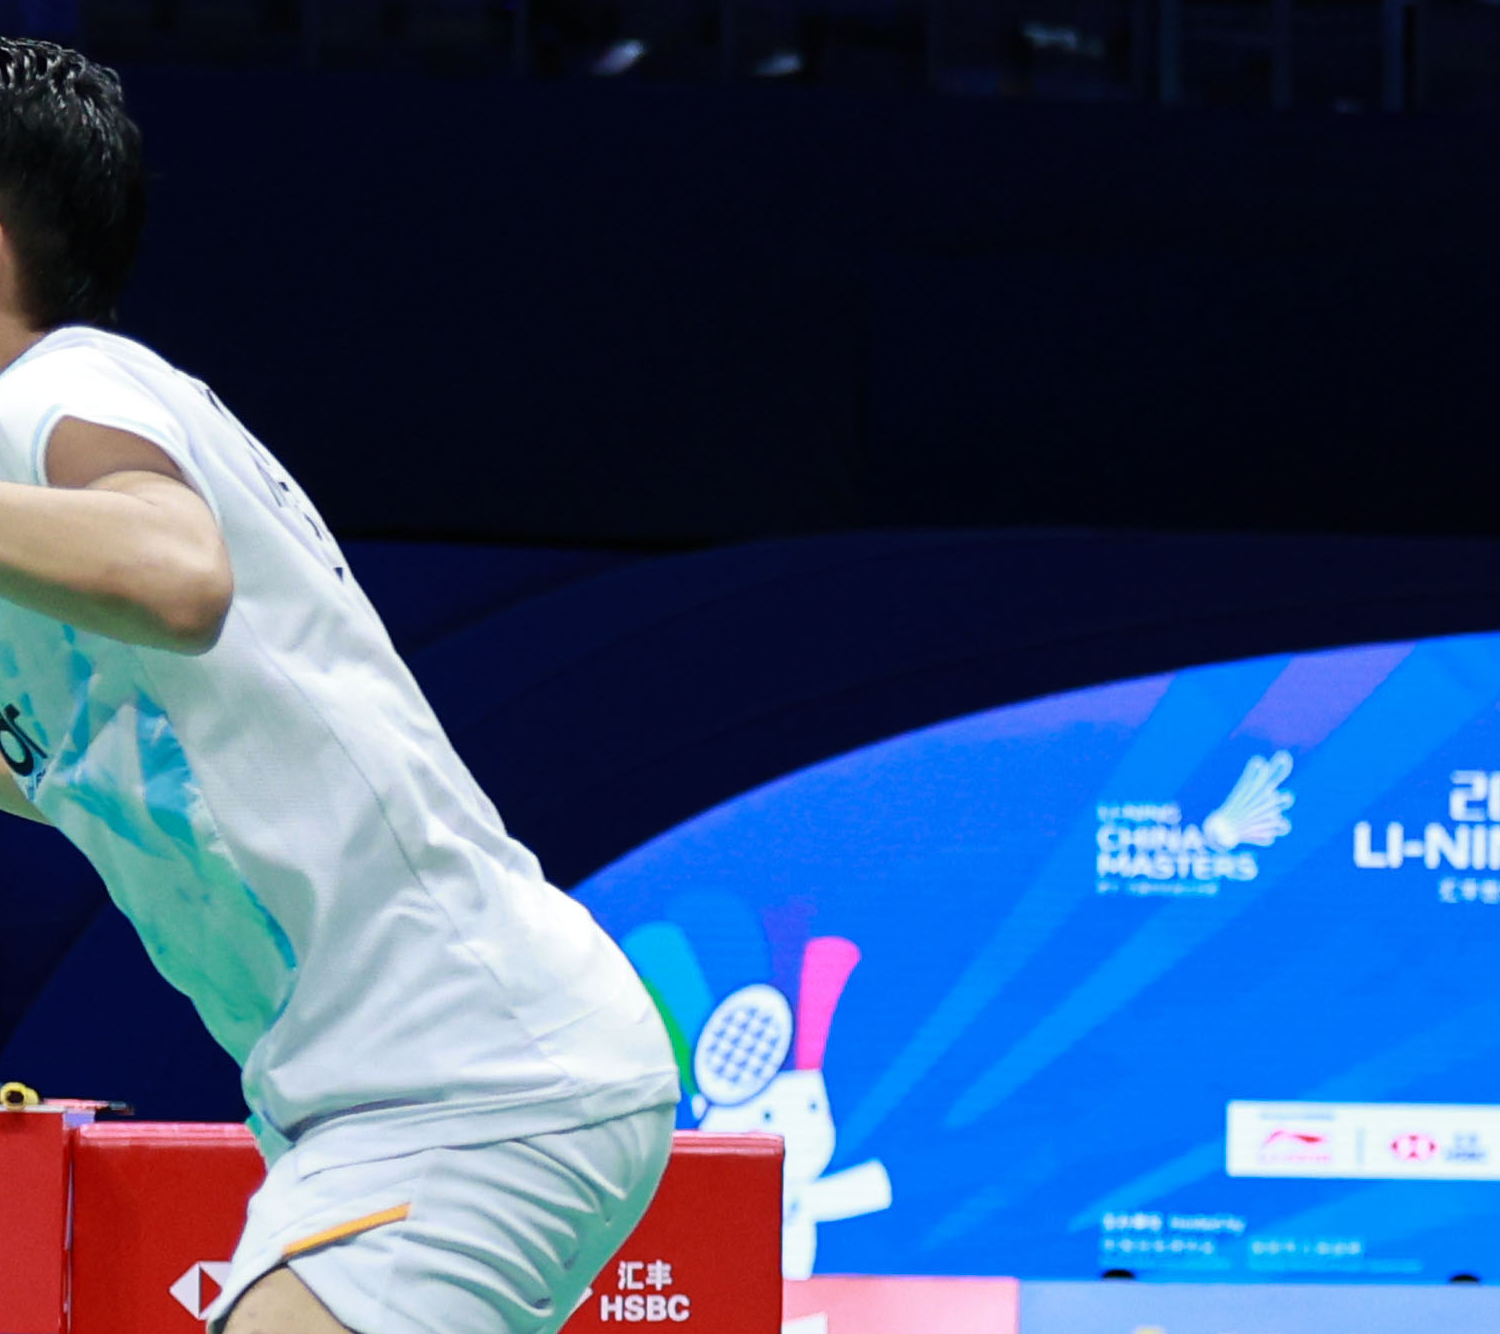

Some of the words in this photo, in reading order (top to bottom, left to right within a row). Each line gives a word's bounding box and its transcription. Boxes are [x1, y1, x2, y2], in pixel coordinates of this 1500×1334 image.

[1096, 824, 1206, 855] CHINA
[1096, 849, 1260, 884] MASTERS
[617, 1260, 673, 1291] 汇丰
[600, 1293, 691, 1322] HSBC
